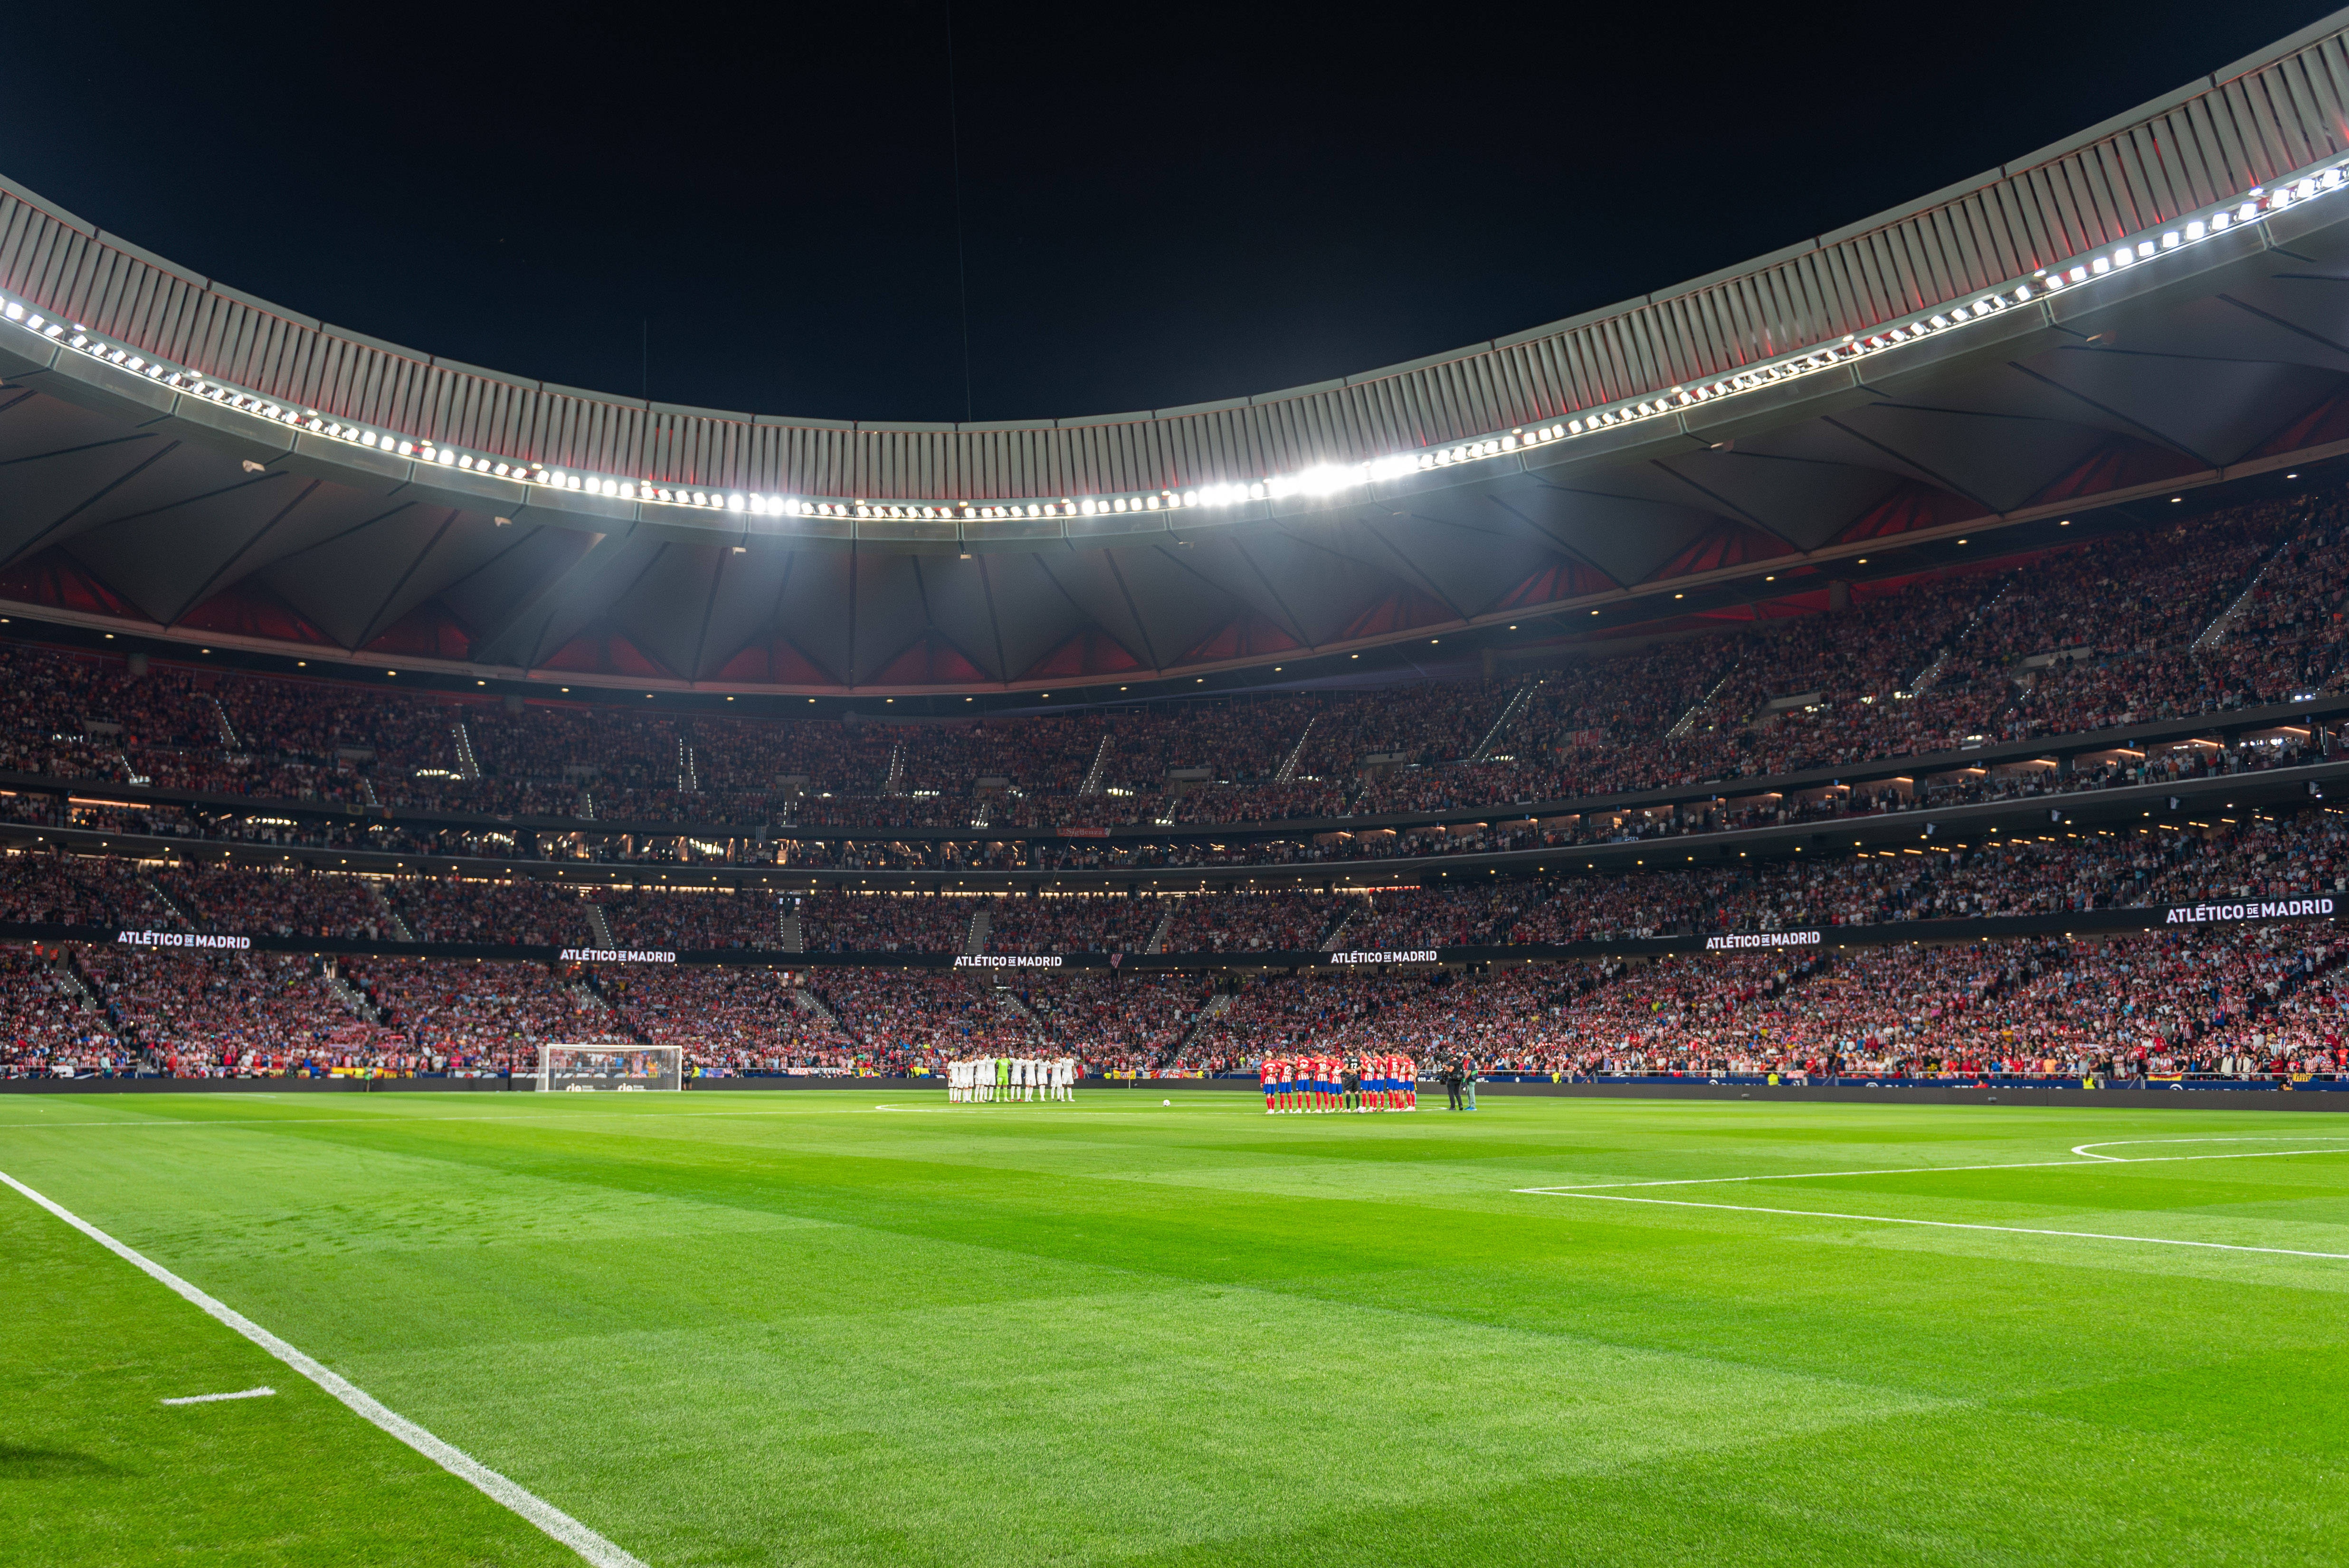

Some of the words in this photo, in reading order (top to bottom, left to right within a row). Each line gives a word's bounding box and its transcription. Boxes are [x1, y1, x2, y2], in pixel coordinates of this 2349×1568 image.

[2166, 903, 2244, 923] ATLÉTICO
[2247, 906, 2259, 916] DE
[2261, 898, 2333, 917] MADRID
[118, 930, 183, 947] ATLÉTICO
[184, 936, 195, 945] DE
[196, 935, 251, 950] MADRID
[1706, 933, 1760, 950] ATLÉTICO
[1761, 936, 1770, 944] DE
[1771, 931, 1820, 946] MADRID
[561, 948, 617, 961] ATLÉTICO
[618, 952, 627, 960] DE
[628, 951, 676, 962] MADRID
[954, 954, 1007, 967] ATLÉTICO
[1017, 956, 1062, 967] MADRID
[1331, 950, 1382, 963] ATLÉTICO
[1383, 953, 1392, 961] DE
[1393, 951, 1437, 962] MADRID
[1284, 1065, 1291, 1075] 12
